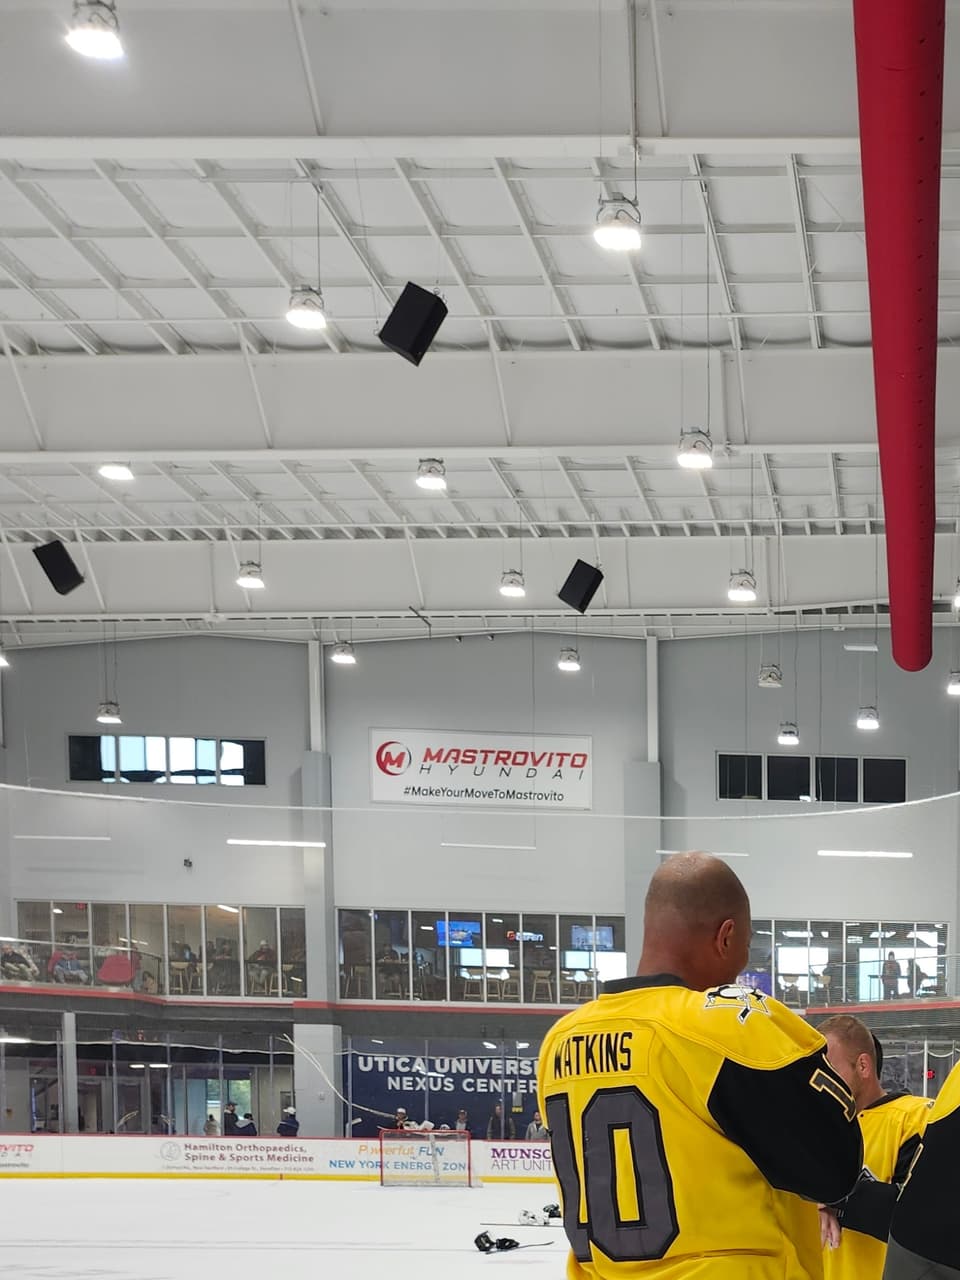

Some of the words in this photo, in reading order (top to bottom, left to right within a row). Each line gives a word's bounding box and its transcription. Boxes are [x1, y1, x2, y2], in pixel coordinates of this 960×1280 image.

[422, 747, 588, 769] MASTROVITO
[419, 764, 584, 781] HYUNDAI
[403, 786, 565, 802] #MakeYourMoveToMastrovito
[554, 1031, 633, 1080] WATKINS
[358, 1056, 428, 1073] UTICA
[387, 1075, 455, 1092] NEXUS
[462, 1078, 539, 1094] CENTER
[184, 1143, 233, 1152] Hamilton
[358, 1144, 415, 1156] Pwerful
[185, 1153, 216, 1163] Spine
[218, 1153, 226, 1161] &
[230, 1153, 265, 1163] Sports
[267, 1154, 315, 1163] Medicine
[329, 1159, 356, 1169] NEW
[360, 1160, 390, 1169] YORK
[394, 1161, 433, 1171] ENERG
[442, 1162, 466, 1171] ZON
[491, 1159, 519, 1171] ART
[544, 1085, 680, 1263] 10
